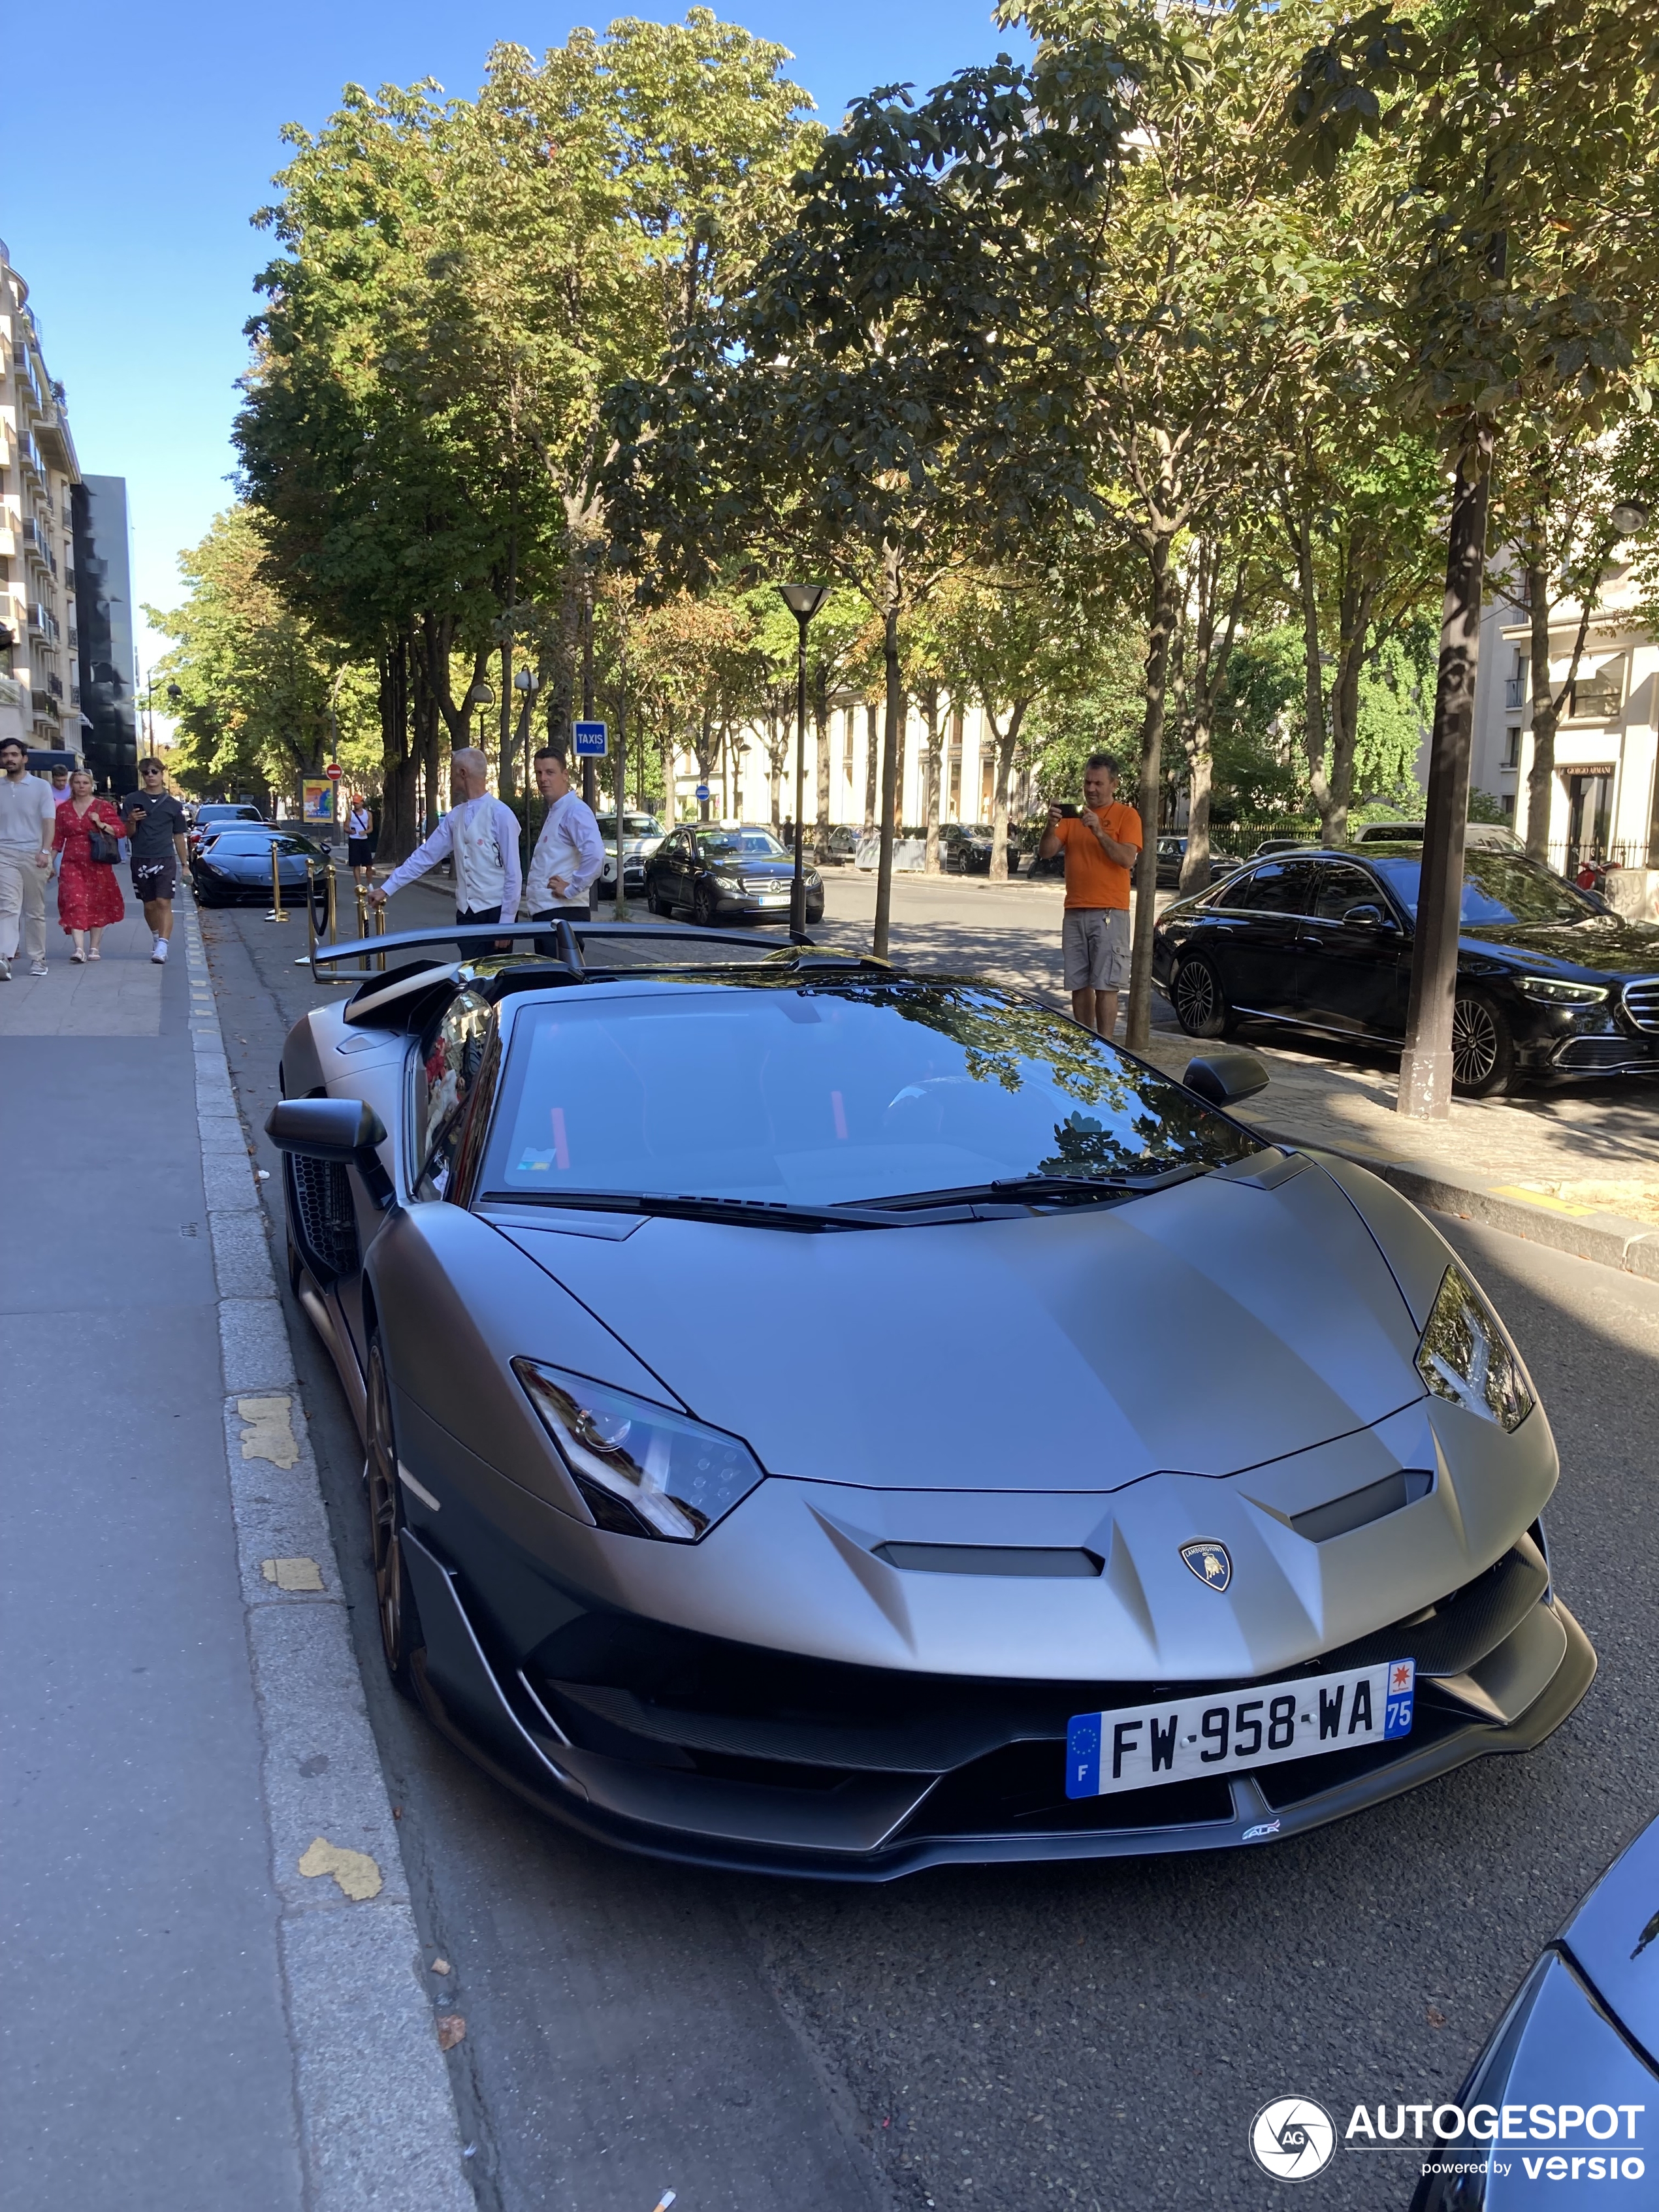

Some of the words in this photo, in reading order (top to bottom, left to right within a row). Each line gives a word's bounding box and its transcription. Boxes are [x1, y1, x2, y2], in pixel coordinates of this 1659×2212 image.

[578, 733, 604, 745] TAXIS
[1185, 1546, 1222, 1557] LAMBORGHINI
[1387, 1700, 1411, 1729] 75
[1078, 1764, 1088, 1782] F
